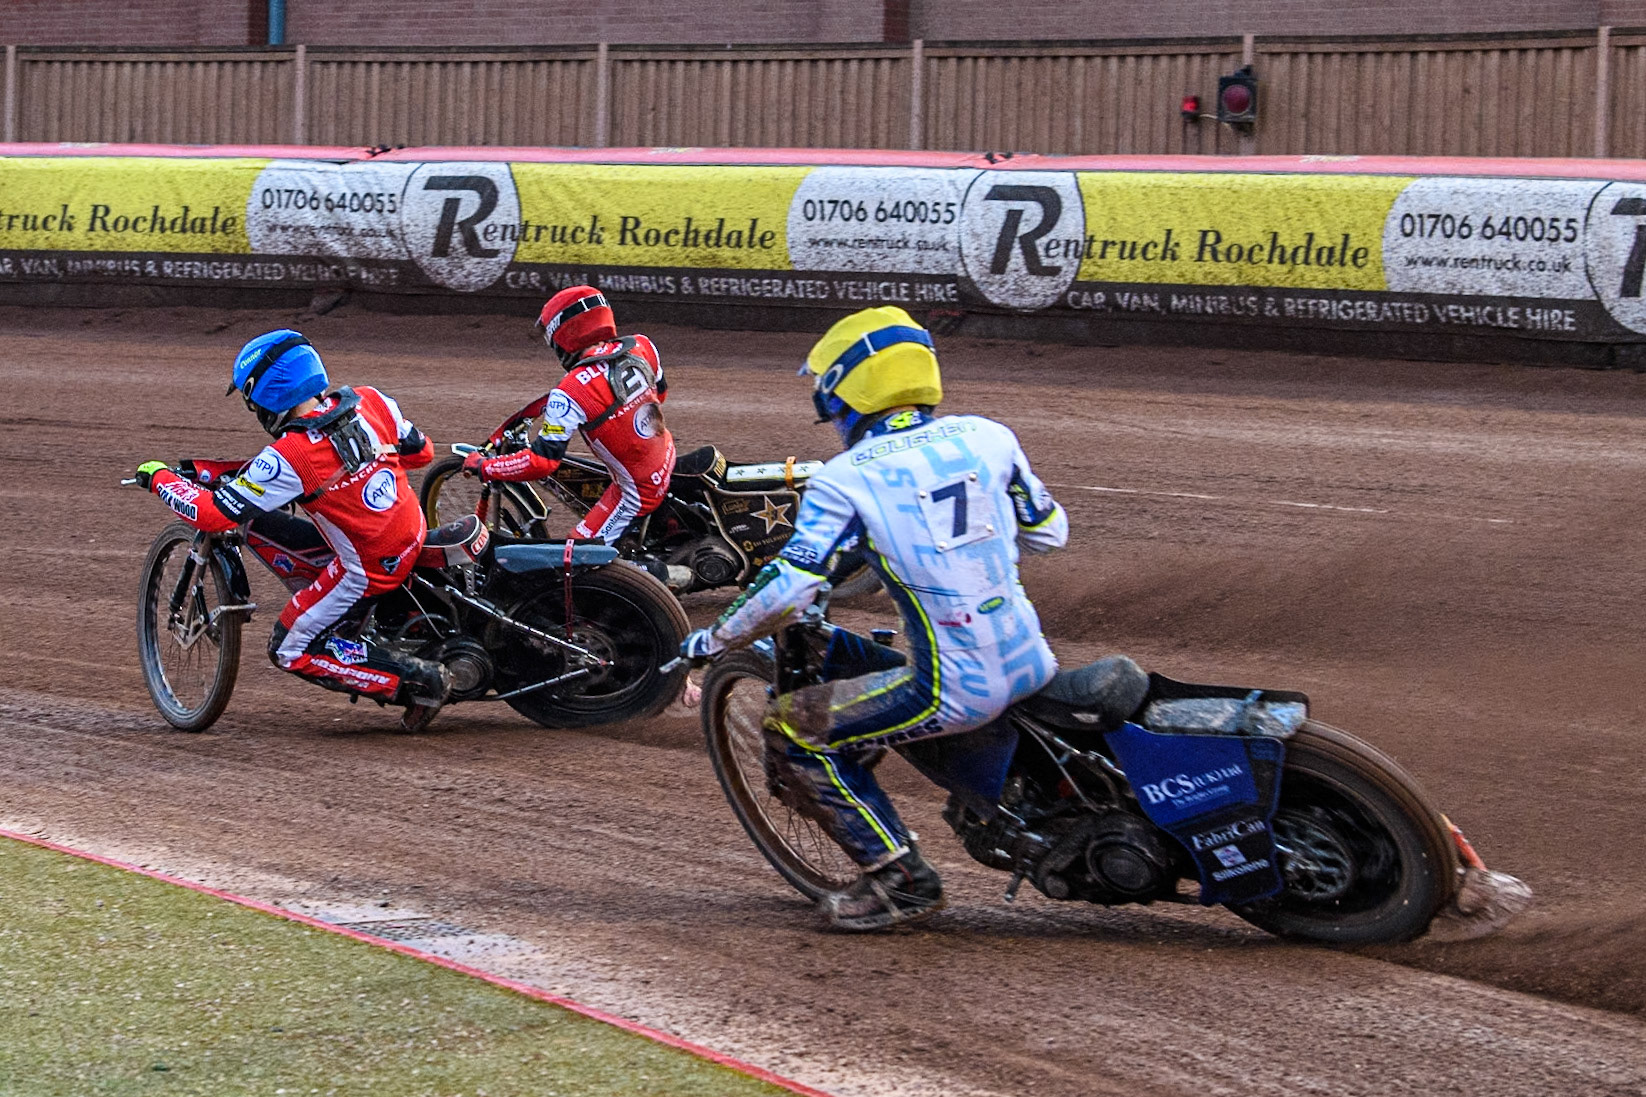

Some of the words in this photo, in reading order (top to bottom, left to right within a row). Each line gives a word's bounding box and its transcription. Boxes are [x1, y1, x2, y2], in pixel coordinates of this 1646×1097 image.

[261, 187, 320, 211] 01706
[325, 192, 397, 214] 640055
[802, 199, 868, 222] 01706
[874, 201, 956, 225] 640055
[0, 204, 75, 232] ruck
[88, 204, 238, 234] Rochdale
[617, 215, 777, 250] Rochdale
[1400, 213, 1473, 240] 01706
[1481, 215, 1579, 243] 640055
[1194, 228, 1369, 268] Rochdale
[1403, 252, 1573, 273] www.rentruck.co.uk
[680, 276, 696, 294] &
[698, 277, 830, 299] REFRIGERATED
[833, 280, 910, 301] VEHICLE
[915, 283, 959, 302] HIRE
[1284, 298, 1429, 323] REFRIGERATED
[1431, 303, 1520, 329] VEHICLE
[1525, 308, 1577, 332] HIRE
[372, 477, 392, 503] ATPI
[931, 481, 969, 539] 7
[1140, 773, 1196, 805] BCS
